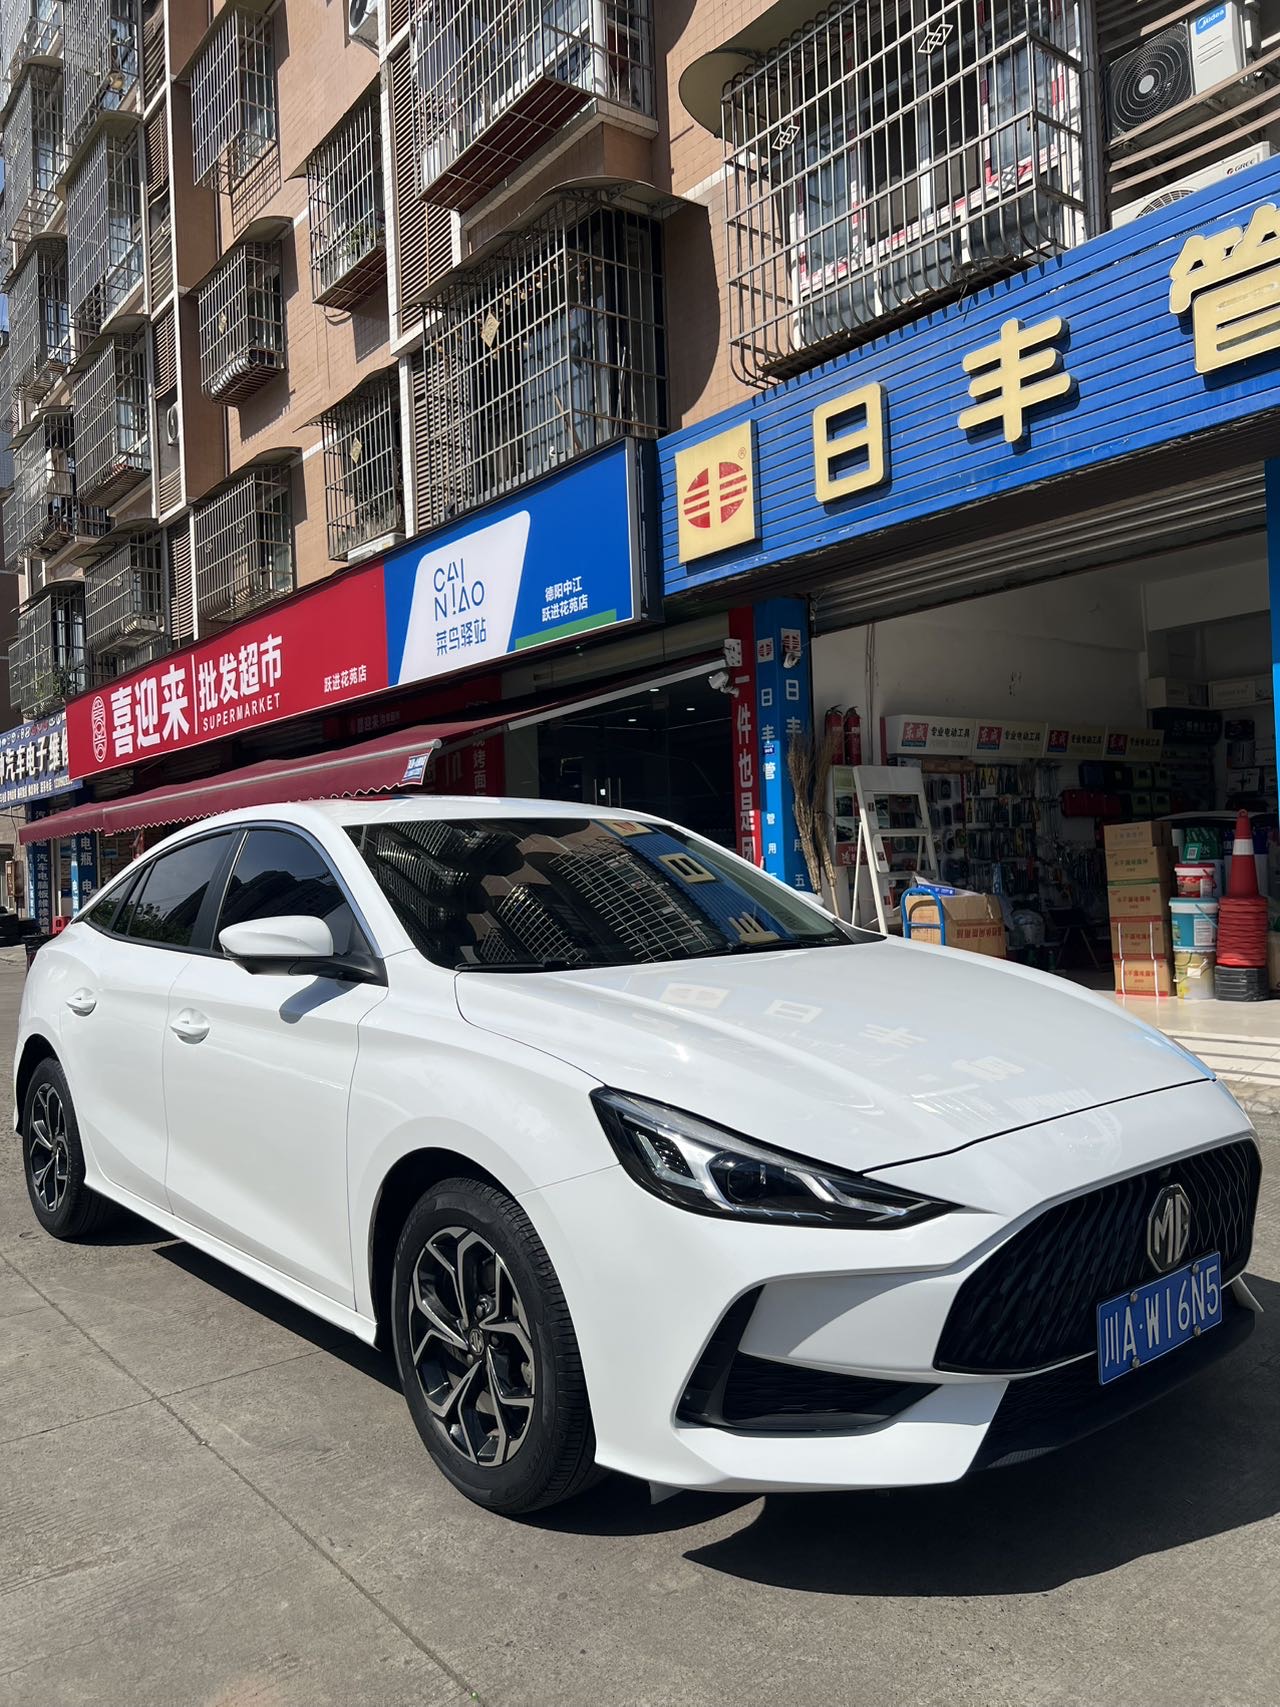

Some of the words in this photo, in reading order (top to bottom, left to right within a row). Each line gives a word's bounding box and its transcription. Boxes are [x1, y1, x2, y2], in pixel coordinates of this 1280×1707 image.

[1198, 9, 1225, 29] Midea
[813, 202, 1280, 505] 日丰管
[433, 558, 465, 593] CAI
[545, 576, 583, 603] 德阳中江
[541, 594, 589, 622] 跃进花苑店
[436, 617, 487, 657] 菜鸟驿站
[110, 663, 190, 758] 喜迎来
[199, 633, 284, 713] 批发超市
[323, 664, 368, 694] 跃进花苑店
[202, 692, 281, 732] SUPERMARKET
[1154, 1194, 1190, 1265] MG
